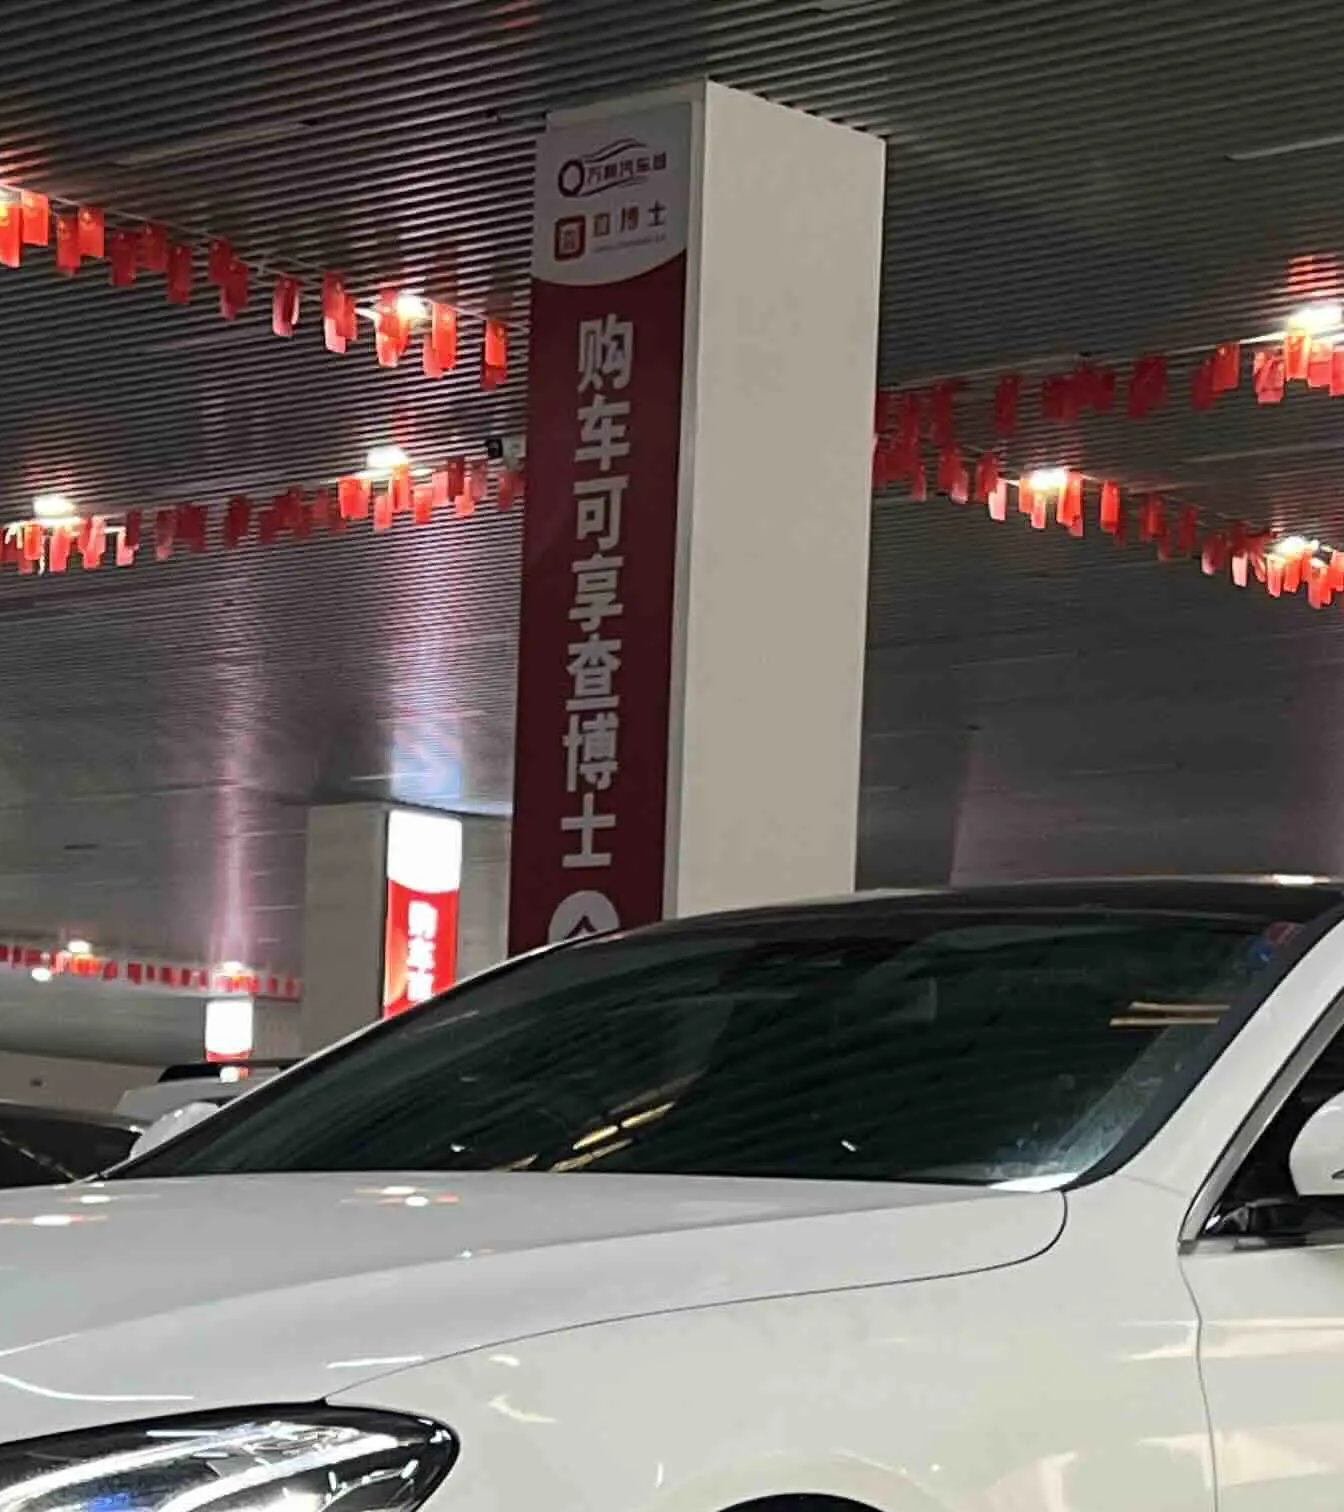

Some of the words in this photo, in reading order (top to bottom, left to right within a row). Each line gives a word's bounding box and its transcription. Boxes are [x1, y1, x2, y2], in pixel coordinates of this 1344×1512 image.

[560, 313, 634, 868] 购车可享查博士
